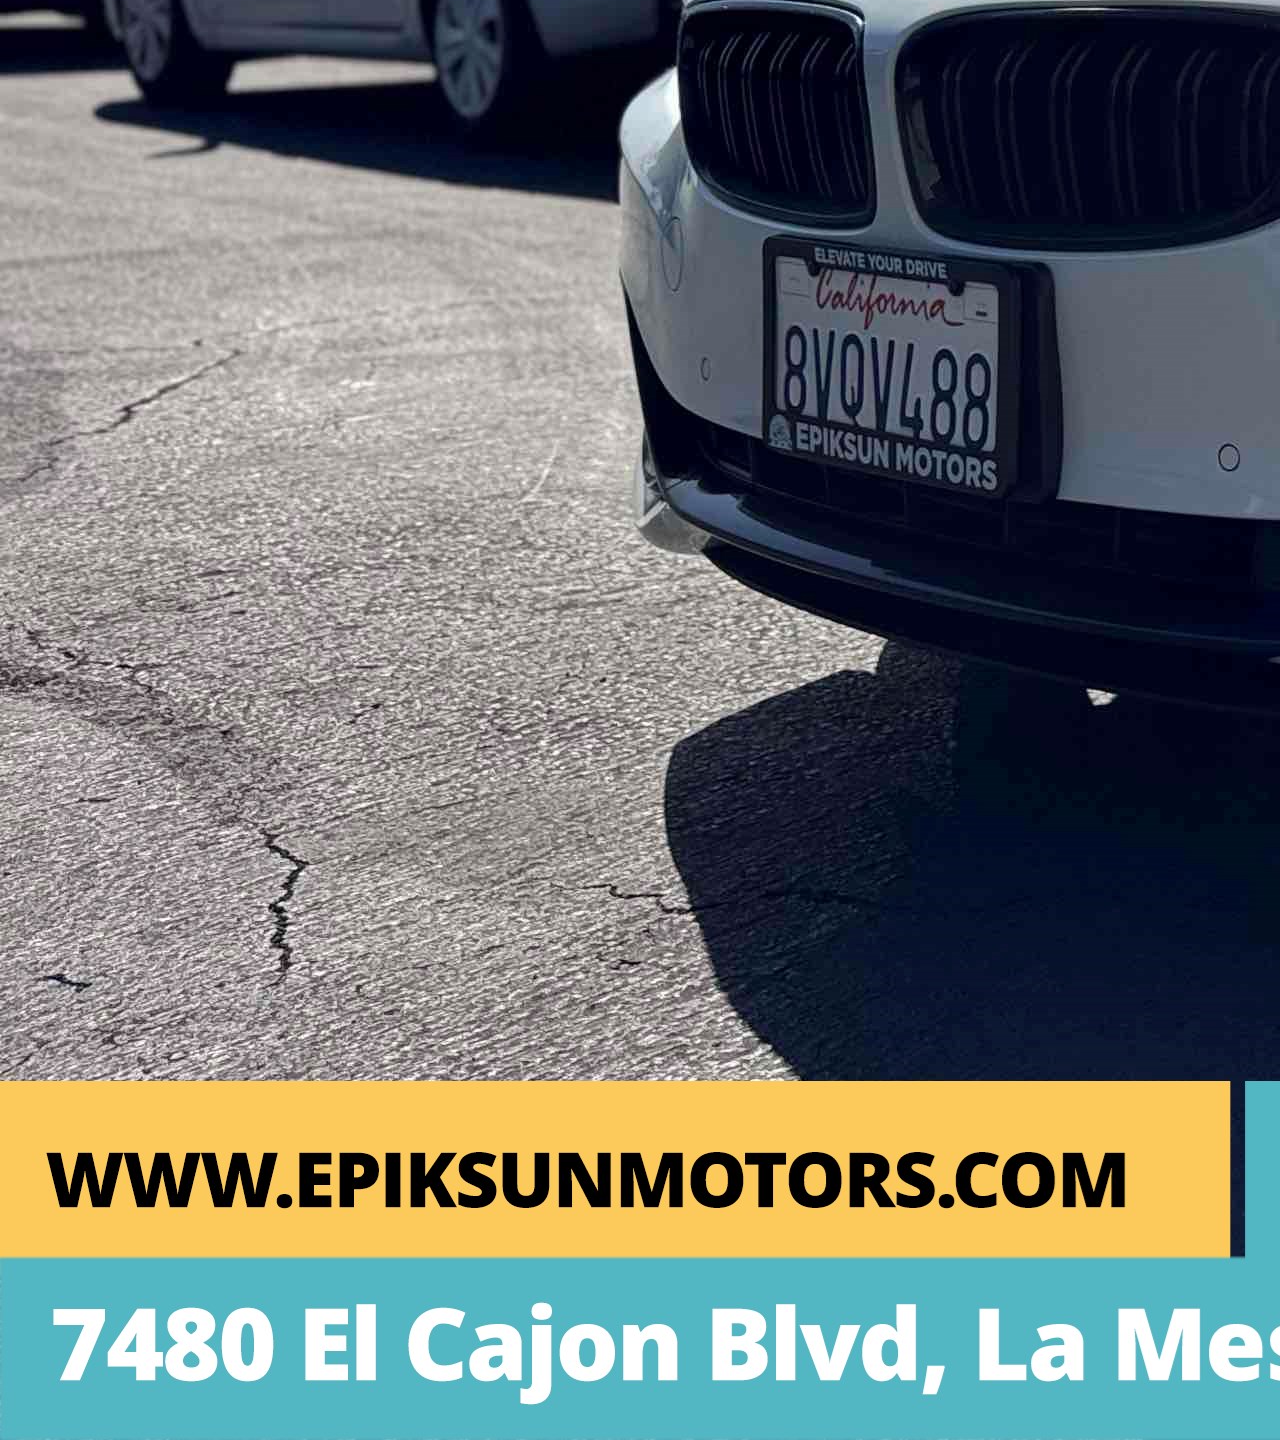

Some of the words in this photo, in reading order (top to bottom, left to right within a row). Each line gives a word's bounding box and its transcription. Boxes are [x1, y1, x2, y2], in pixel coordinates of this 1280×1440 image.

[814, 248, 865, 268] ELEVATE
[867, 253, 902, 273] YOUR
[906, 260, 948, 279] DRIVE
[816, 267, 965, 330] California
[784, 325, 992, 450] 8VQV488
[796, 422, 889, 469] EPIKSUN
[896, 442, 998, 491] MOTORS
